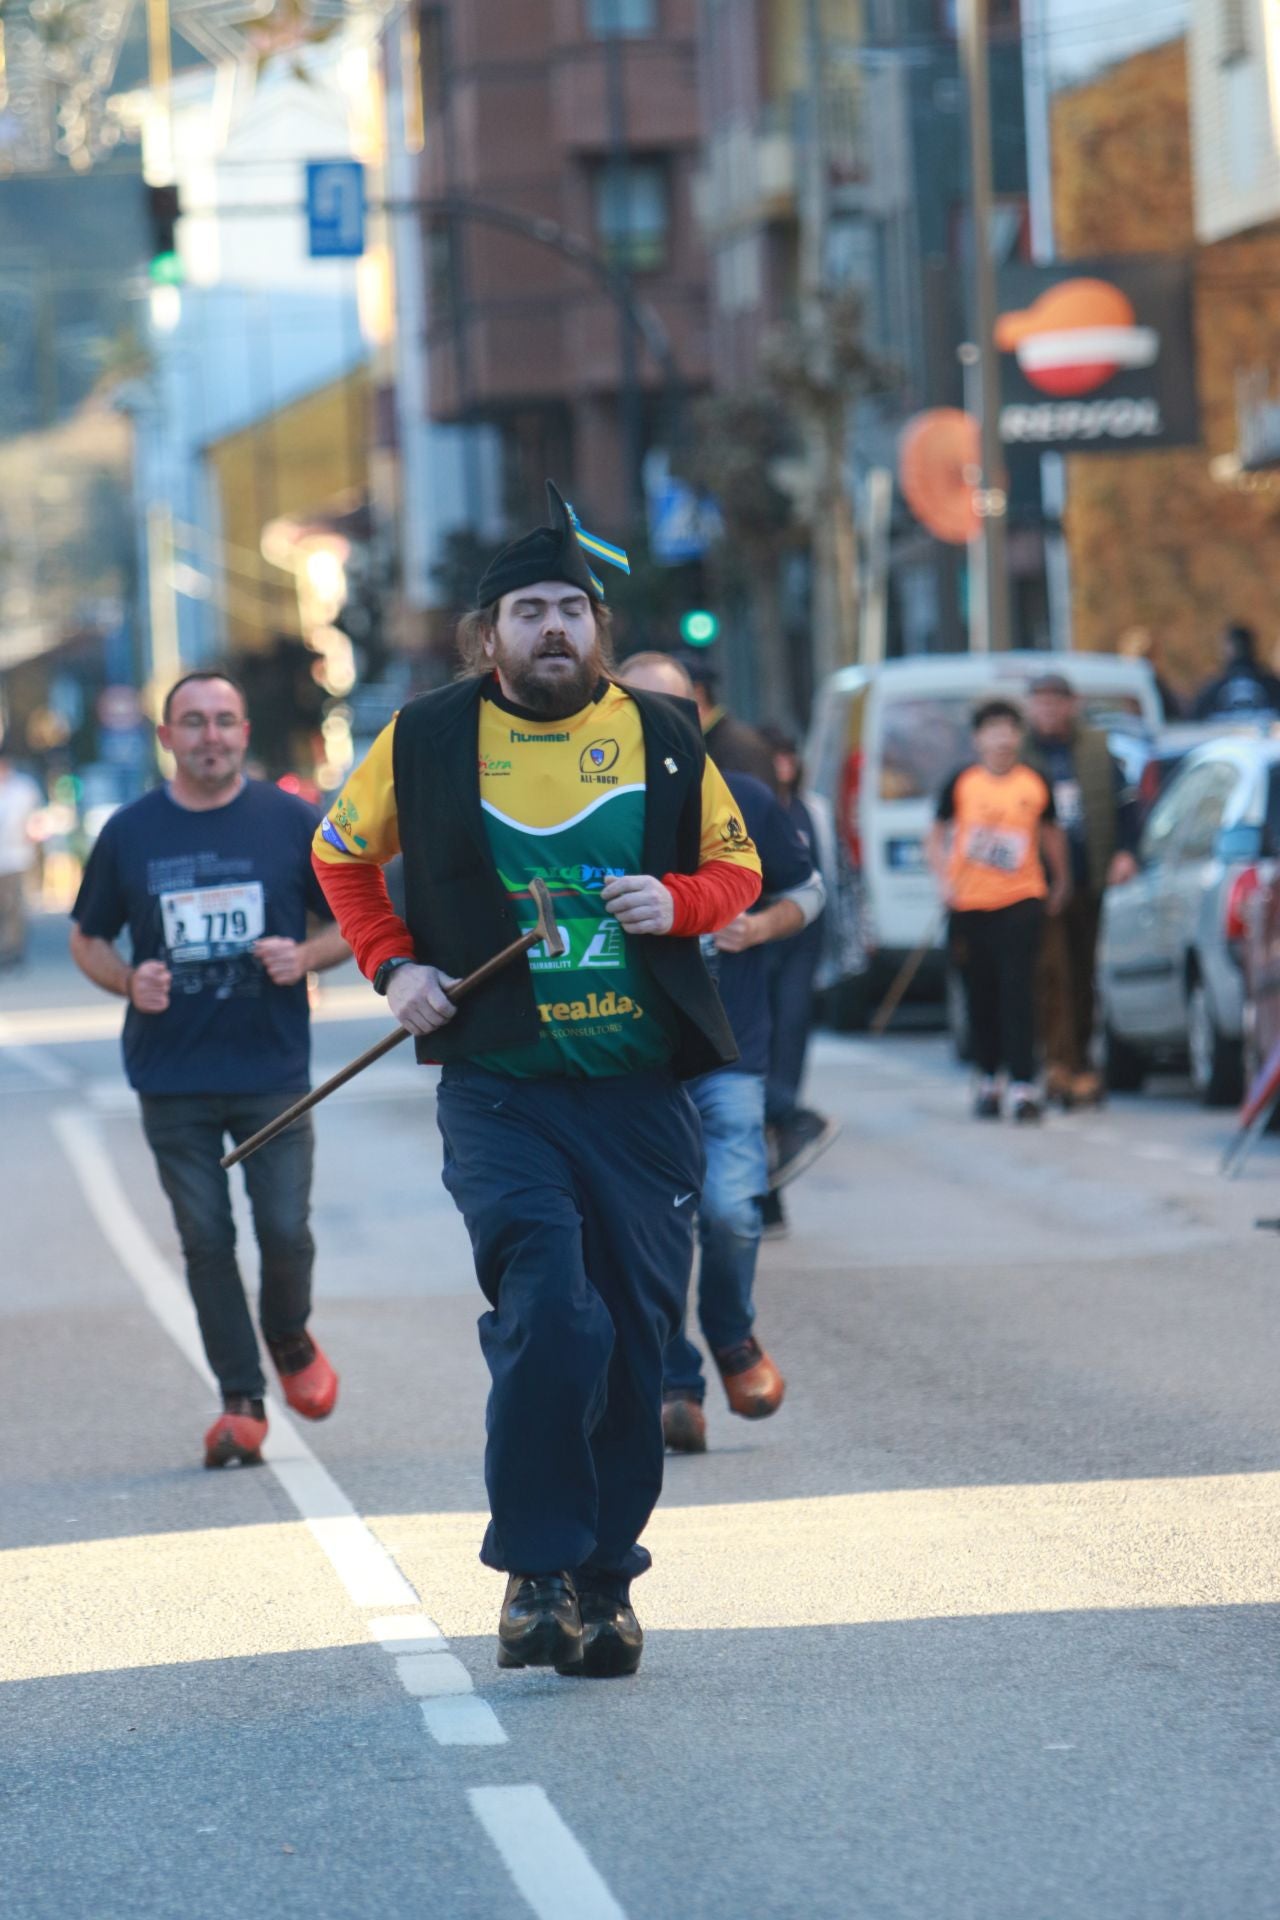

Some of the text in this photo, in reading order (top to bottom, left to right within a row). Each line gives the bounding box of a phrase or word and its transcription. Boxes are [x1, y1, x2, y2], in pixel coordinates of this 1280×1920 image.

[1000, 398, 1162, 442] REPSOL
[511, 730, 570, 743] hummel
[202, 910, 248, 941] 779
